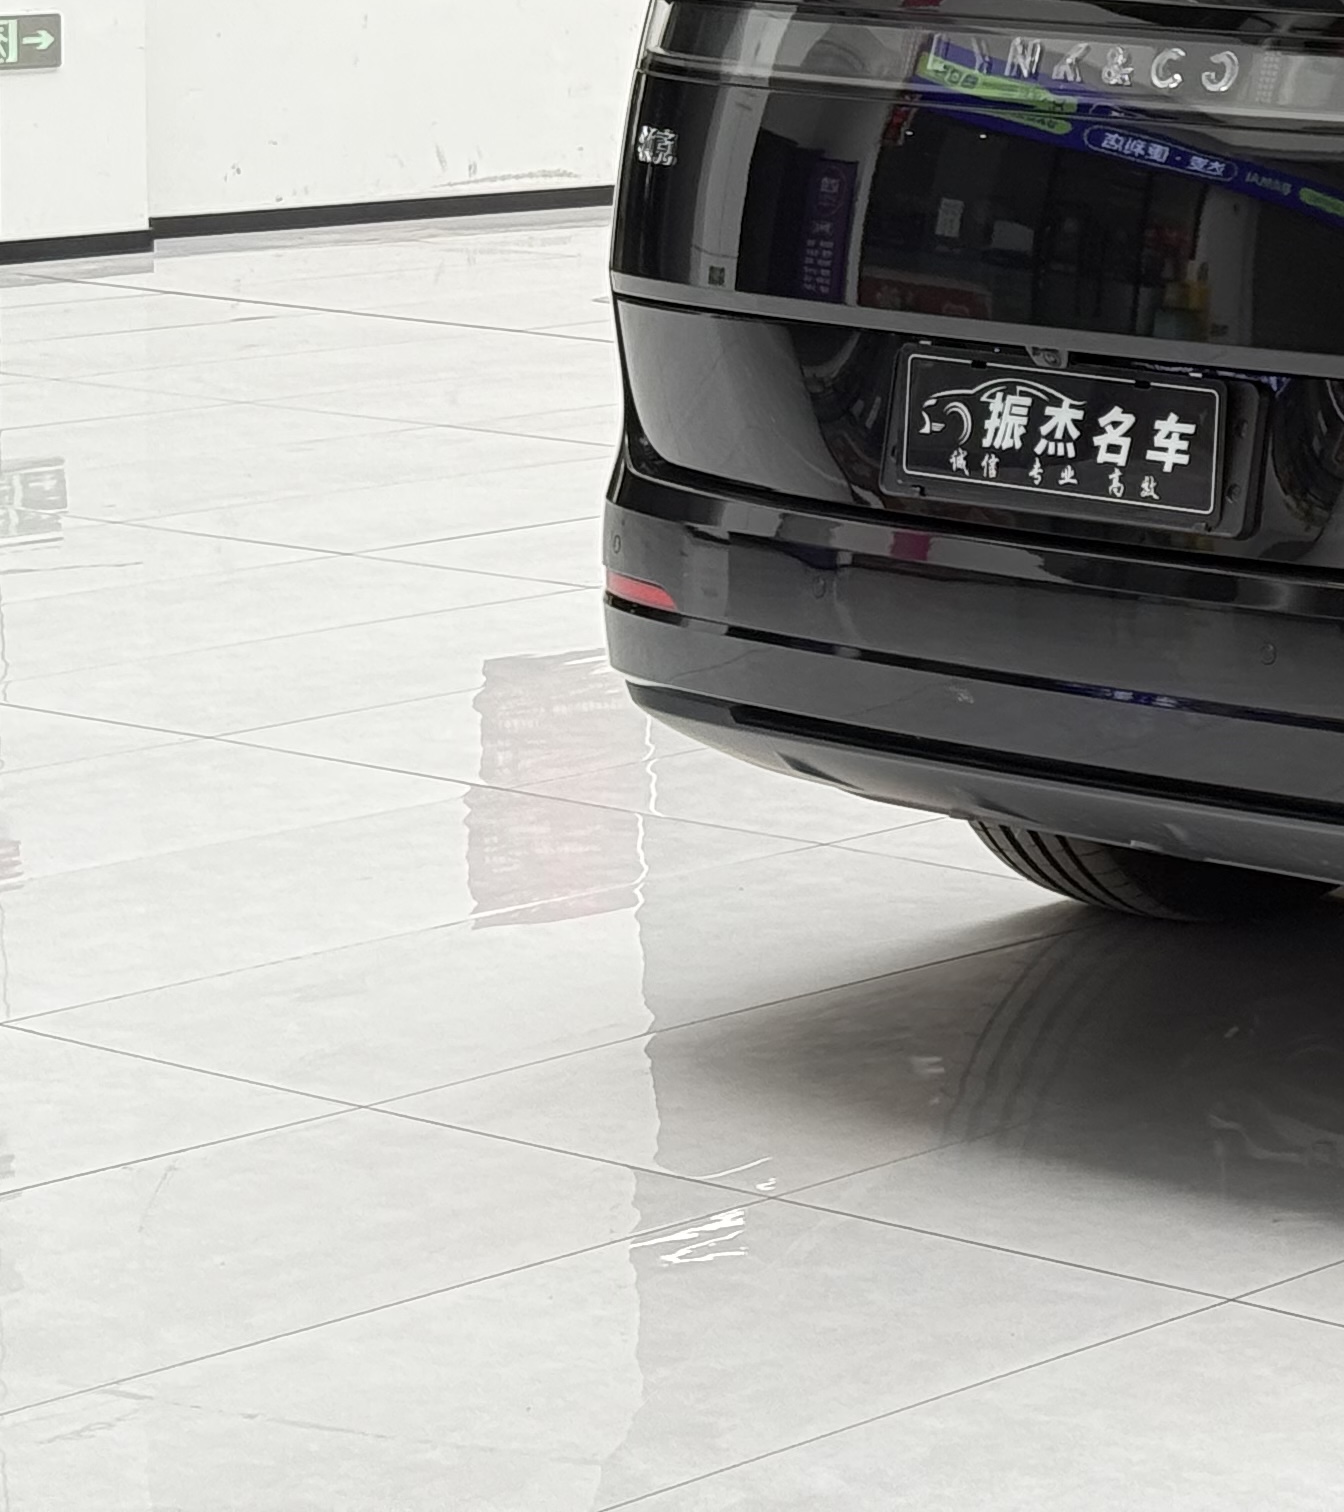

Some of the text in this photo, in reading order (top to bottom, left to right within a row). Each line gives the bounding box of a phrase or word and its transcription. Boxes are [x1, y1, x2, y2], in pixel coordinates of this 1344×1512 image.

[980, 391, 1197, 474] 振杰名车
[949, 447, 1162, 501] 诚信 专业 高效
